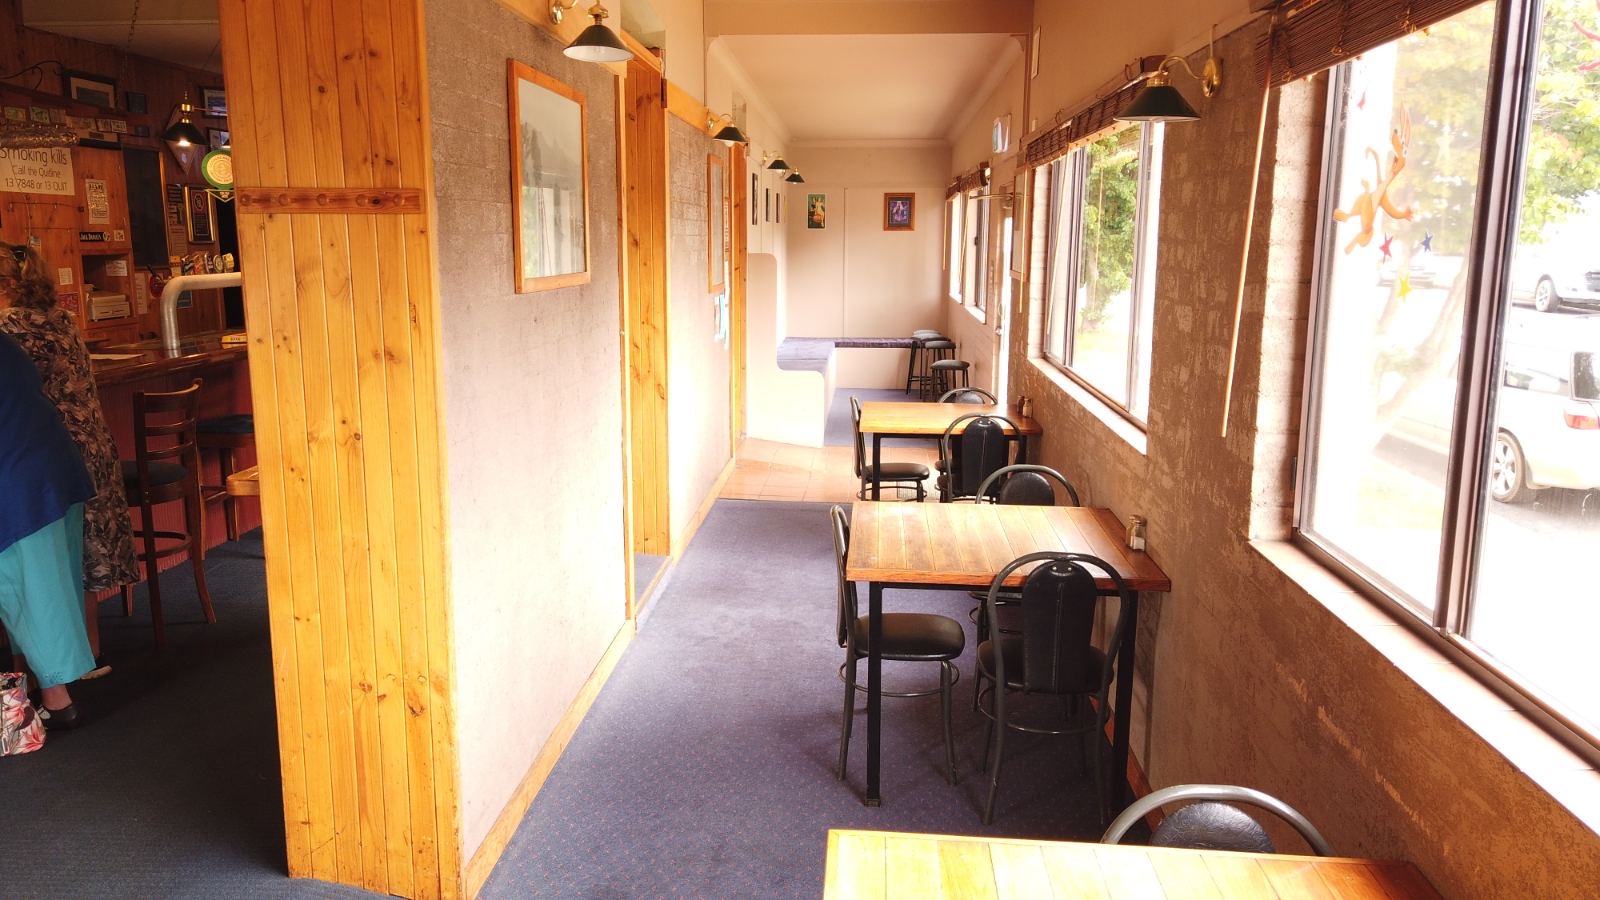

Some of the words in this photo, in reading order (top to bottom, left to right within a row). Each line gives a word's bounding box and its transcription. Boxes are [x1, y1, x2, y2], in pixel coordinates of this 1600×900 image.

[0, 149, 48, 166] Smoking
[51, 149, 68, 165] kills
[5, 177, 14, 188] 13
